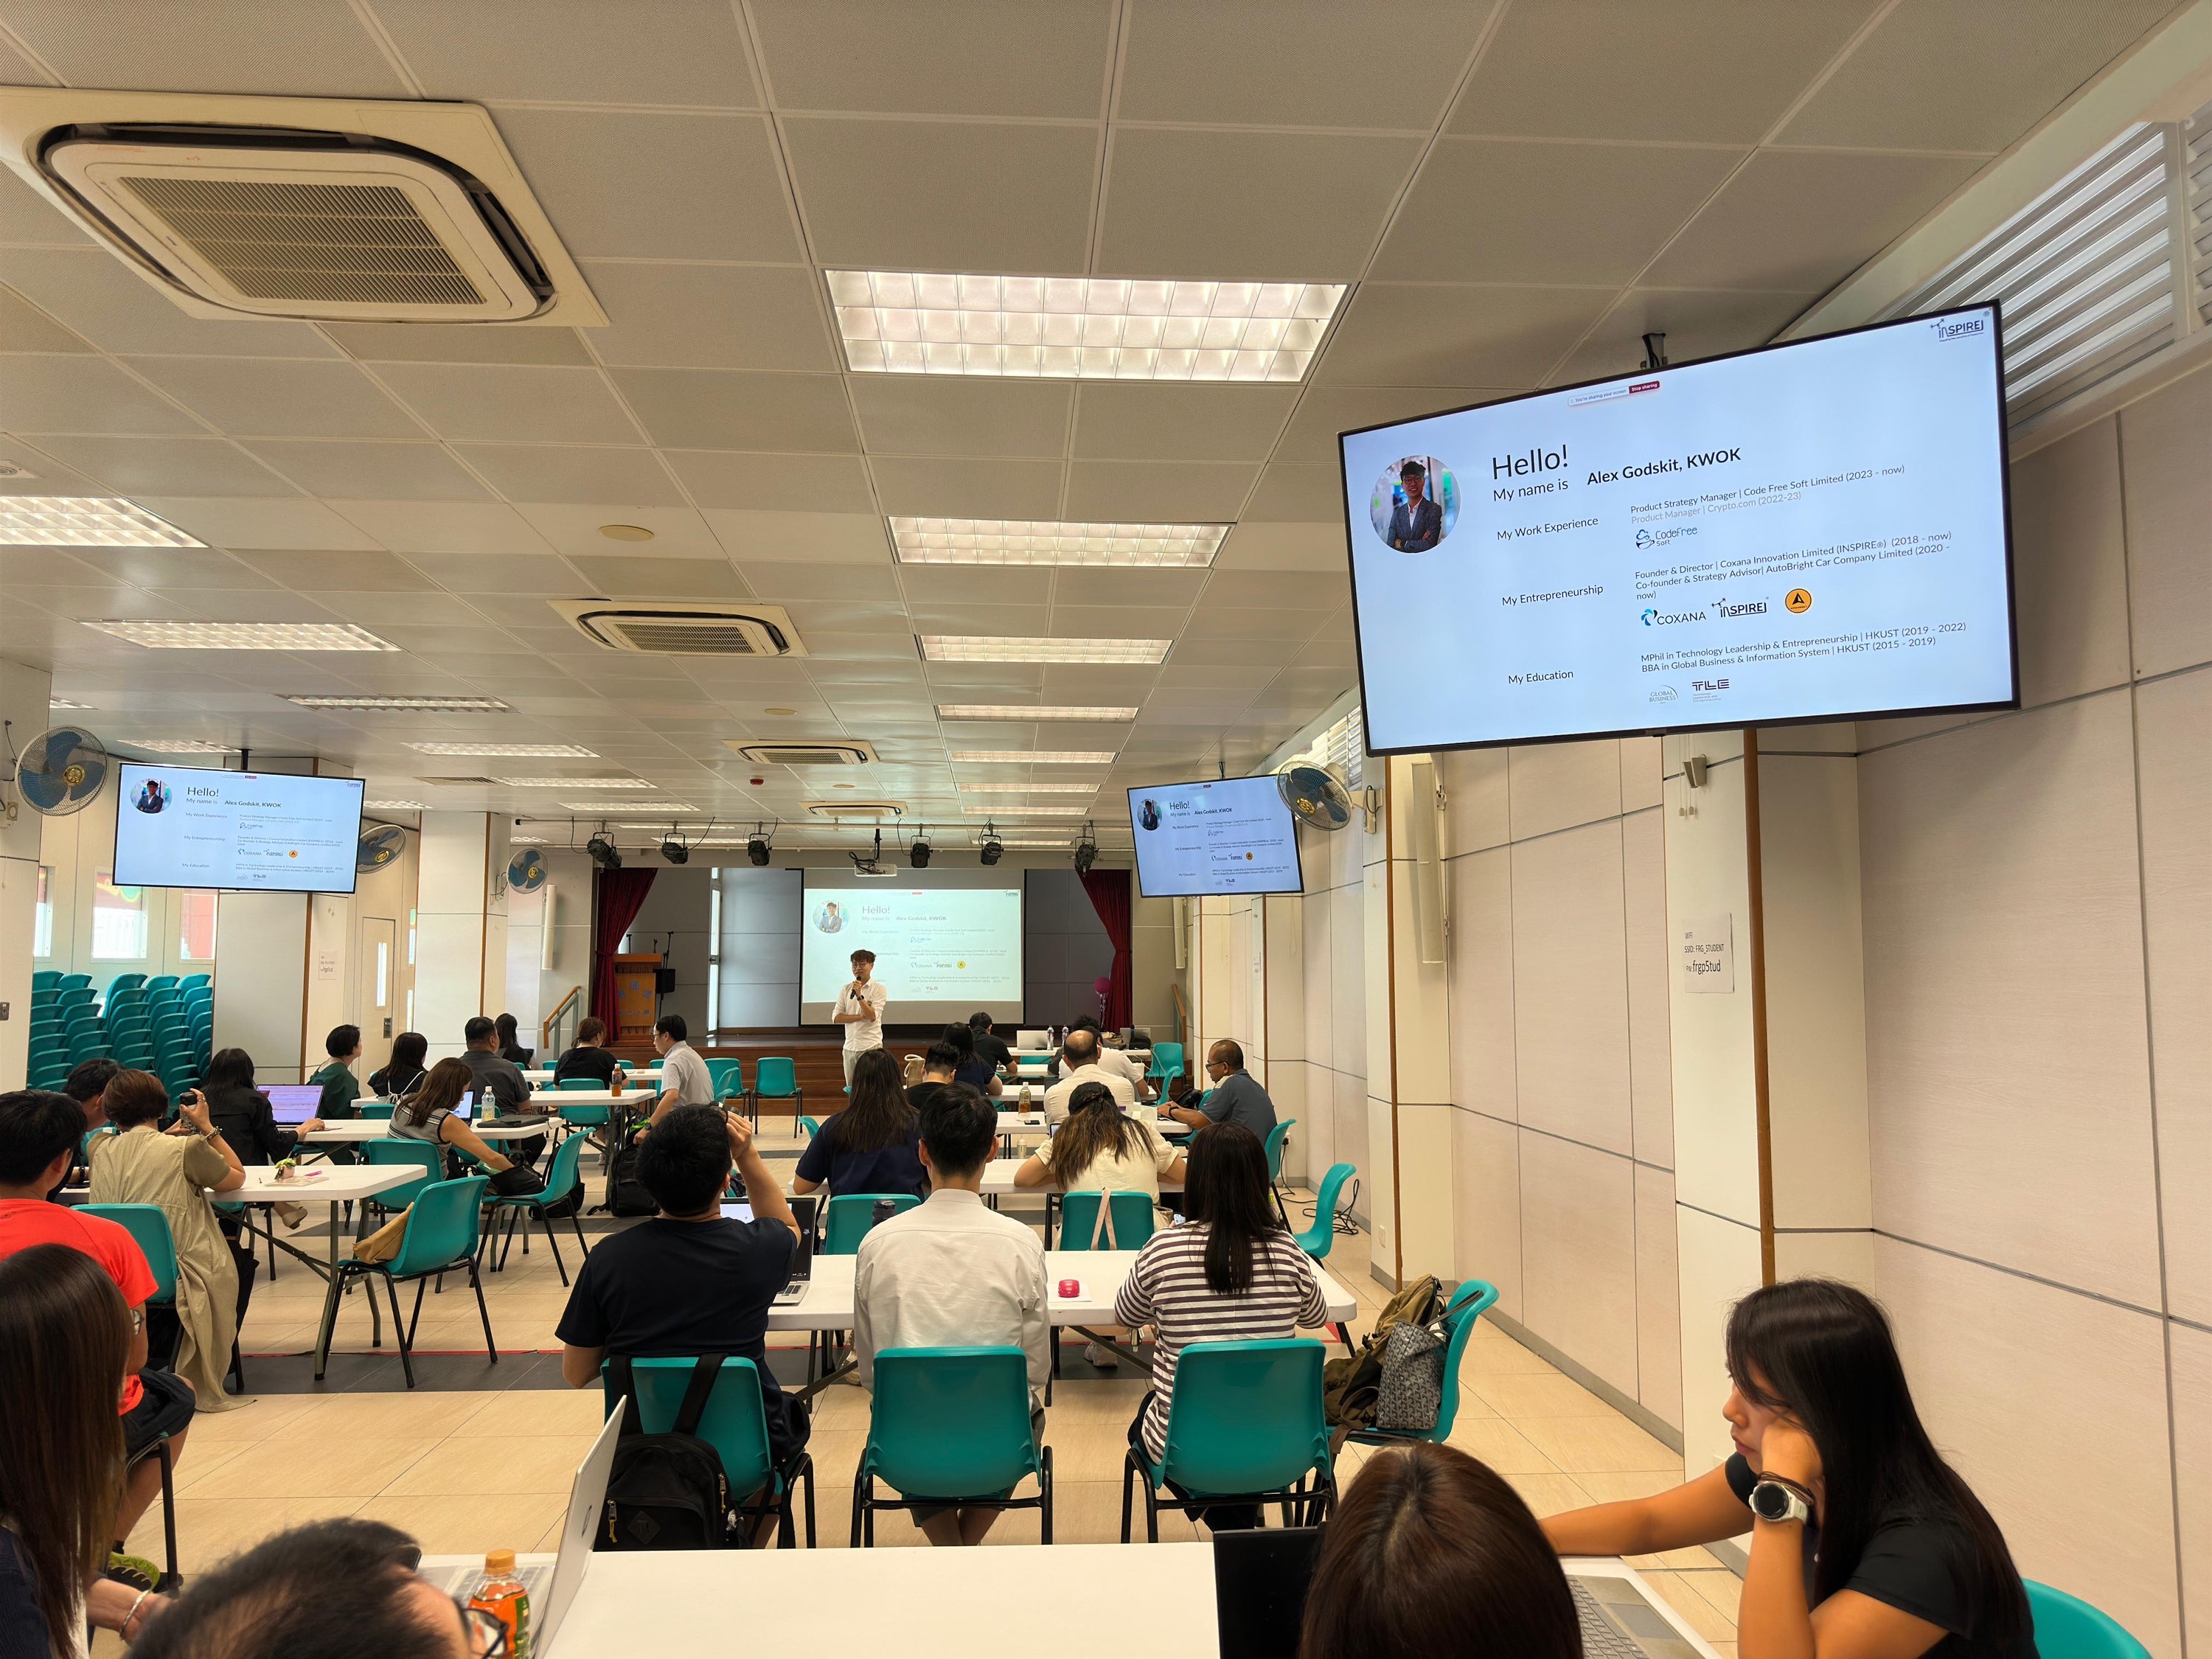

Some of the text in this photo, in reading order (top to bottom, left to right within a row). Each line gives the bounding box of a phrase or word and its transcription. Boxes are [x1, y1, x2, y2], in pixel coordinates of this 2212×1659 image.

[1492, 443, 1568, 480] Hello!
[1493, 447, 1742, 502] My name is Alex Godskit, KWOK
[1630, 502, 1663, 514] Product
[1663, 498, 1698, 509] Strategy
[1700, 492, 1737, 504] Manager
[1743, 486, 1767, 496] Code
[1768, 484, 1788, 493] Free
[1790, 479, 1809, 490] Soft
[1810, 473, 1844, 487] Limited
[1846, 469, 1873, 482] (2023
[1882, 464, 1905, 476] now)
[1631, 512, 1663, 524] Product
[1664, 507, 1701, 520] Manager
[1707, 499, 1756, 513] Crypto.com
[1758, 490, 1801, 507] (2022-23)
[1497, 518, 1599, 540] My Work Experience
[1655, 539, 1671, 547] Soft
[1635, 568, 1669, 580] Founder
[1670, 566, 1678, 575] &
[1679, 563, 1714, 574] Director
[1719, 558, 1752, 568] Coxana
[1753, 552, 1800, 564] Innovation
[1801, 546, 1834, 558] Limited
[1891, 535, 1919, 548] (2018
[1927, 531, 1952, 542] now)
[1635, 577, 1683, 590] Co-founder
[1683, 575, 1691, 584] &
[1692, 572, 1728, 582] Strategy
[1765, 560, 1814, 574] AutoBright
[1815, 558, 1832, 567] Car
[1833, 554, 1877, 565] Company
[1878, 547, 1913, 560] Limited
[1915, 543, 1944, 557] (2020
[1501, 584, 1604, 607] My Entrepreneurship
[1636, 590, 1657, 600] now)
[1656, 611, 1707, 625] COXANA
[1641, 653, 1665, 662] MPhil
[1666, 652, 1674, 660] in
[1674, 647, 1723, 659] Technology
[1725, 642, 1771, 654] Leadership
[1773, 640, 1781, 650] &
[1782, 633, 1858, 648] Entrepreneurship
[1865, 628, 1899, 640] HKUST
[1901, 626, 1929, 638] (2019
[1938, 622, 1966, 633] 2022)
[1641, 663, 1660, 672] BBA
[1661, 663, 1669, 671] in
[1671, 659, 1697, 669] Global
[1699, 658, 1735, 667] Business
[1736, 655, 1745, 664] &
[1746, 650, 1796, 663] Information
[1798, 648, 1830, 658] System
[1837, 642, 1871, 654] HKUST
[1872, 640, 1899, 652] (2015
[1908, 636, 1936, 647] 2019)
[1508, 669, 1573, 685] My Education
[187, 787, 219, 797] Hello!
[1169, 800, 1190, 810] Hello!
[862, 905, 890, 914] Hello!
[1695, 944, 1725, 954] FRG_STUDENT
